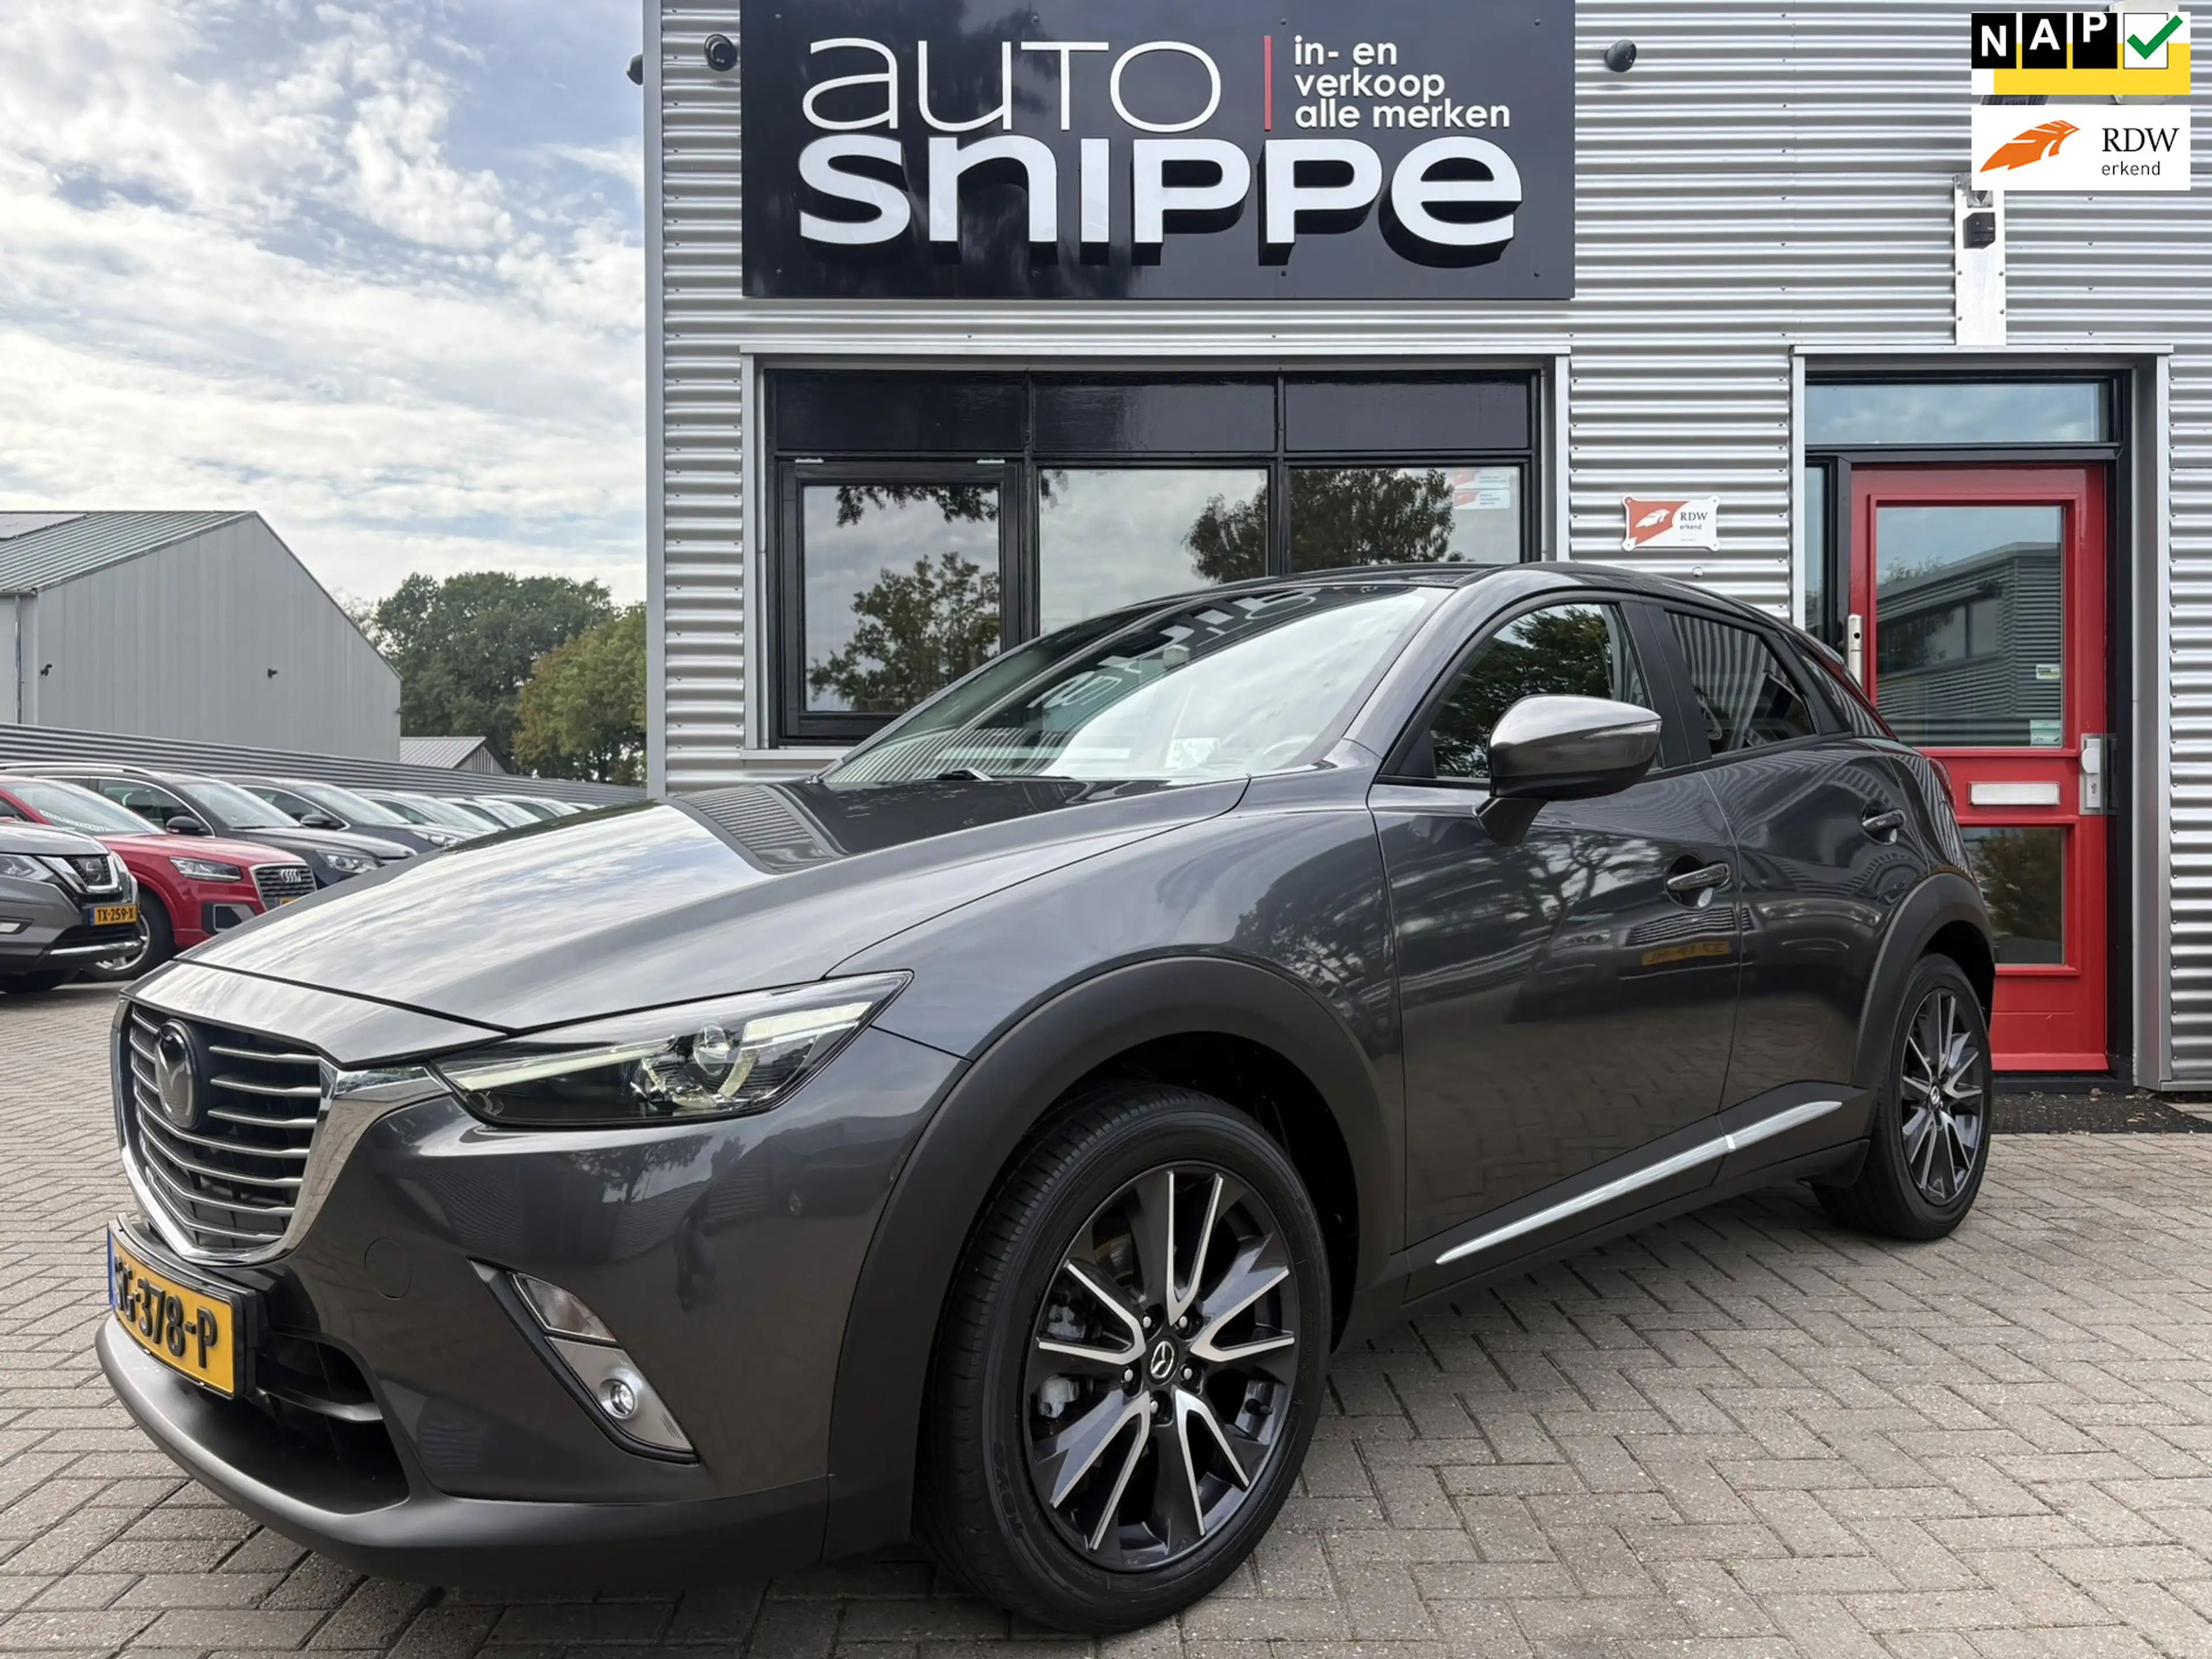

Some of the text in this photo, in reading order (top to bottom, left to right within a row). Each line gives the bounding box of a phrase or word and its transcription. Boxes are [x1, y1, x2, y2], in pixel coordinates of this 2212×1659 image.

[1294, 35, 1397, 66] in- en
[1294, 66, 1445, 103] verkoop
[1294, 98, 1510, 128] alle merken
[1680, 512, 1708, 521] RDW
